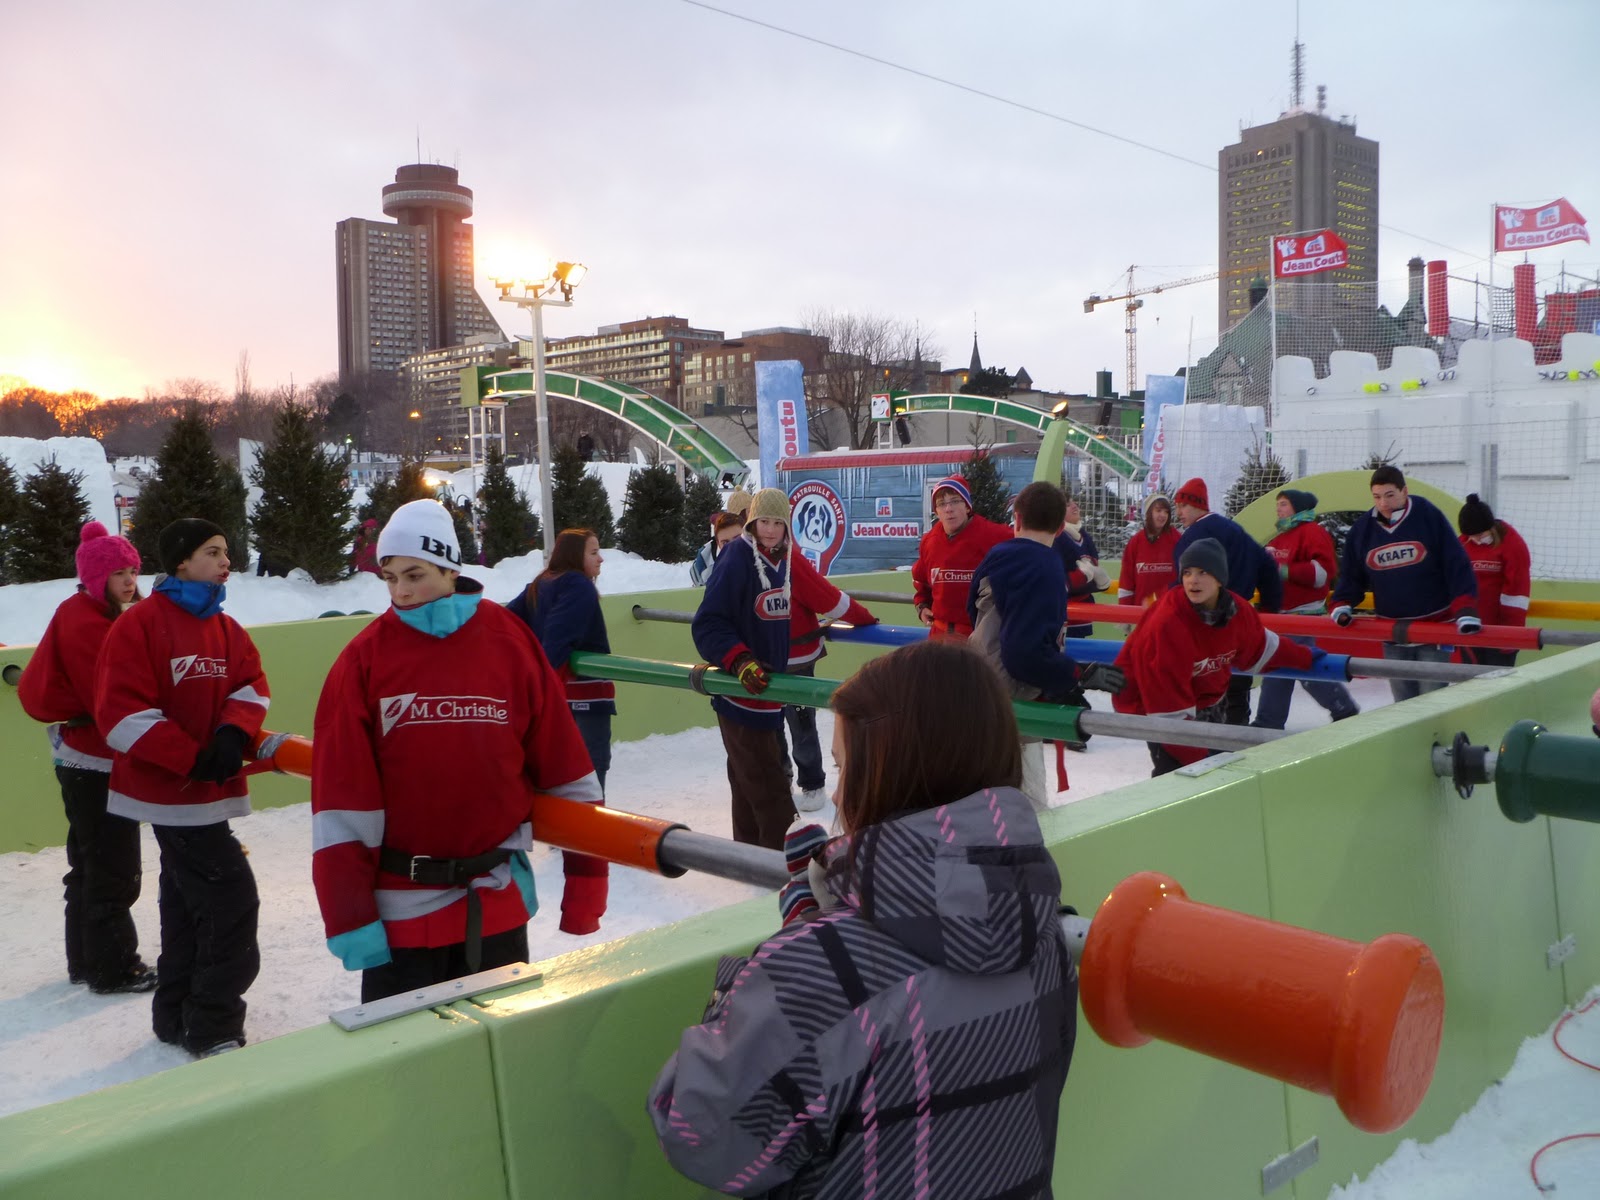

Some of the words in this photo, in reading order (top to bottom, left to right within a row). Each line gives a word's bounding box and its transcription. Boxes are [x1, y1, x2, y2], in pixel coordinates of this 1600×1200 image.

[1507, 233, 1545, 246] Jean
[1546, 223, 1587, 241] Coutu
[1283, 260, 1312, 272] Jean
[780, 401, 797, 458] outu
[792, 484, 831, 502] PATROUILLE
[853, 523, 882, 537] Jean
[882, 523, 919, 537] Coutu
[1377, 547, 1415, 564] KRAFT
[944, 571, 974, 581] Christi
[194, 661, 210, 674] M.
[410, 702, 434, 719] M.
[436, 701, 508, 720] Christie
